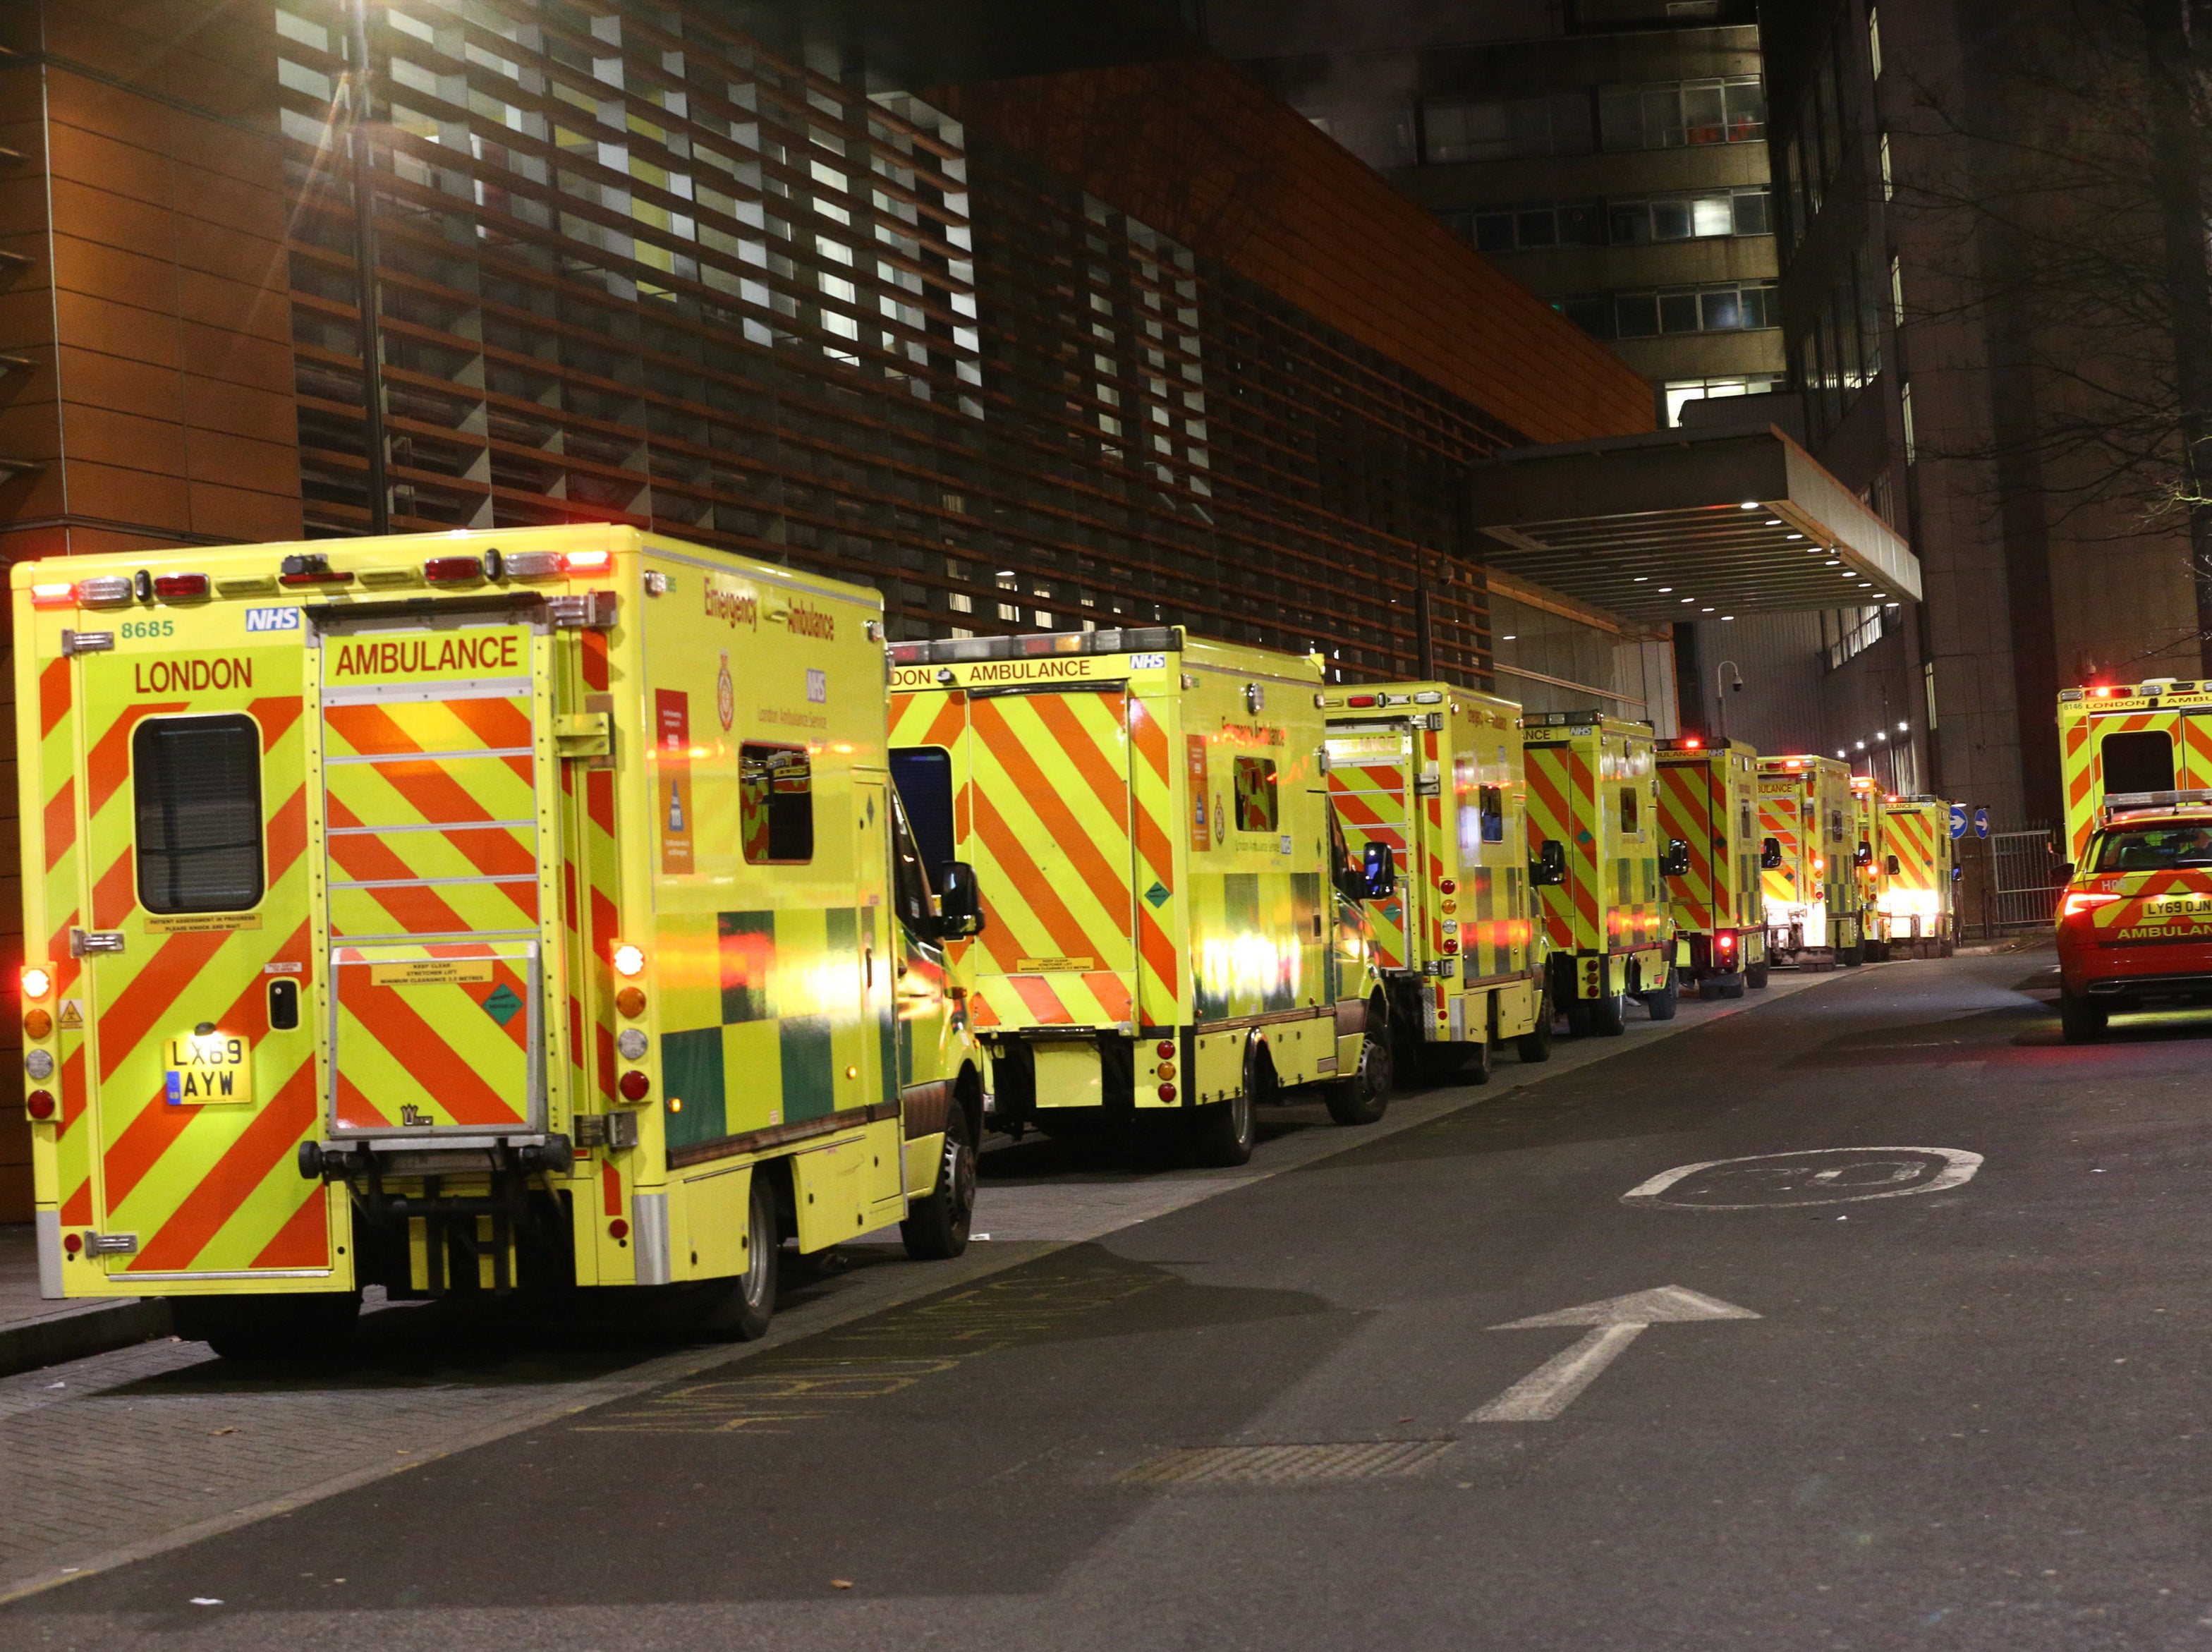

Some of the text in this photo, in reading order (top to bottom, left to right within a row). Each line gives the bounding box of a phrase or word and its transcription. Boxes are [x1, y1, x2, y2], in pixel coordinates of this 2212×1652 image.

[704, 576, 834, 641] Emergency Ambulance
[121, 621, 174, 638] 8685
[248, 608, 298, 631] NHS
[135, 636, 518, 693] LONDON AMBULANCE
[970, 660, 1091, 681] AMBULANCE
[1130, 654, 1165, 669] NHS
[2086, 700, 2145, 709] LONDON
[1708, 748, 1725, 757] NHS
[2148, 901, 2182, 915] LY69
[173, 1039, 242, 1066] LX69
[184, 1071, 233, 1096] AYW
